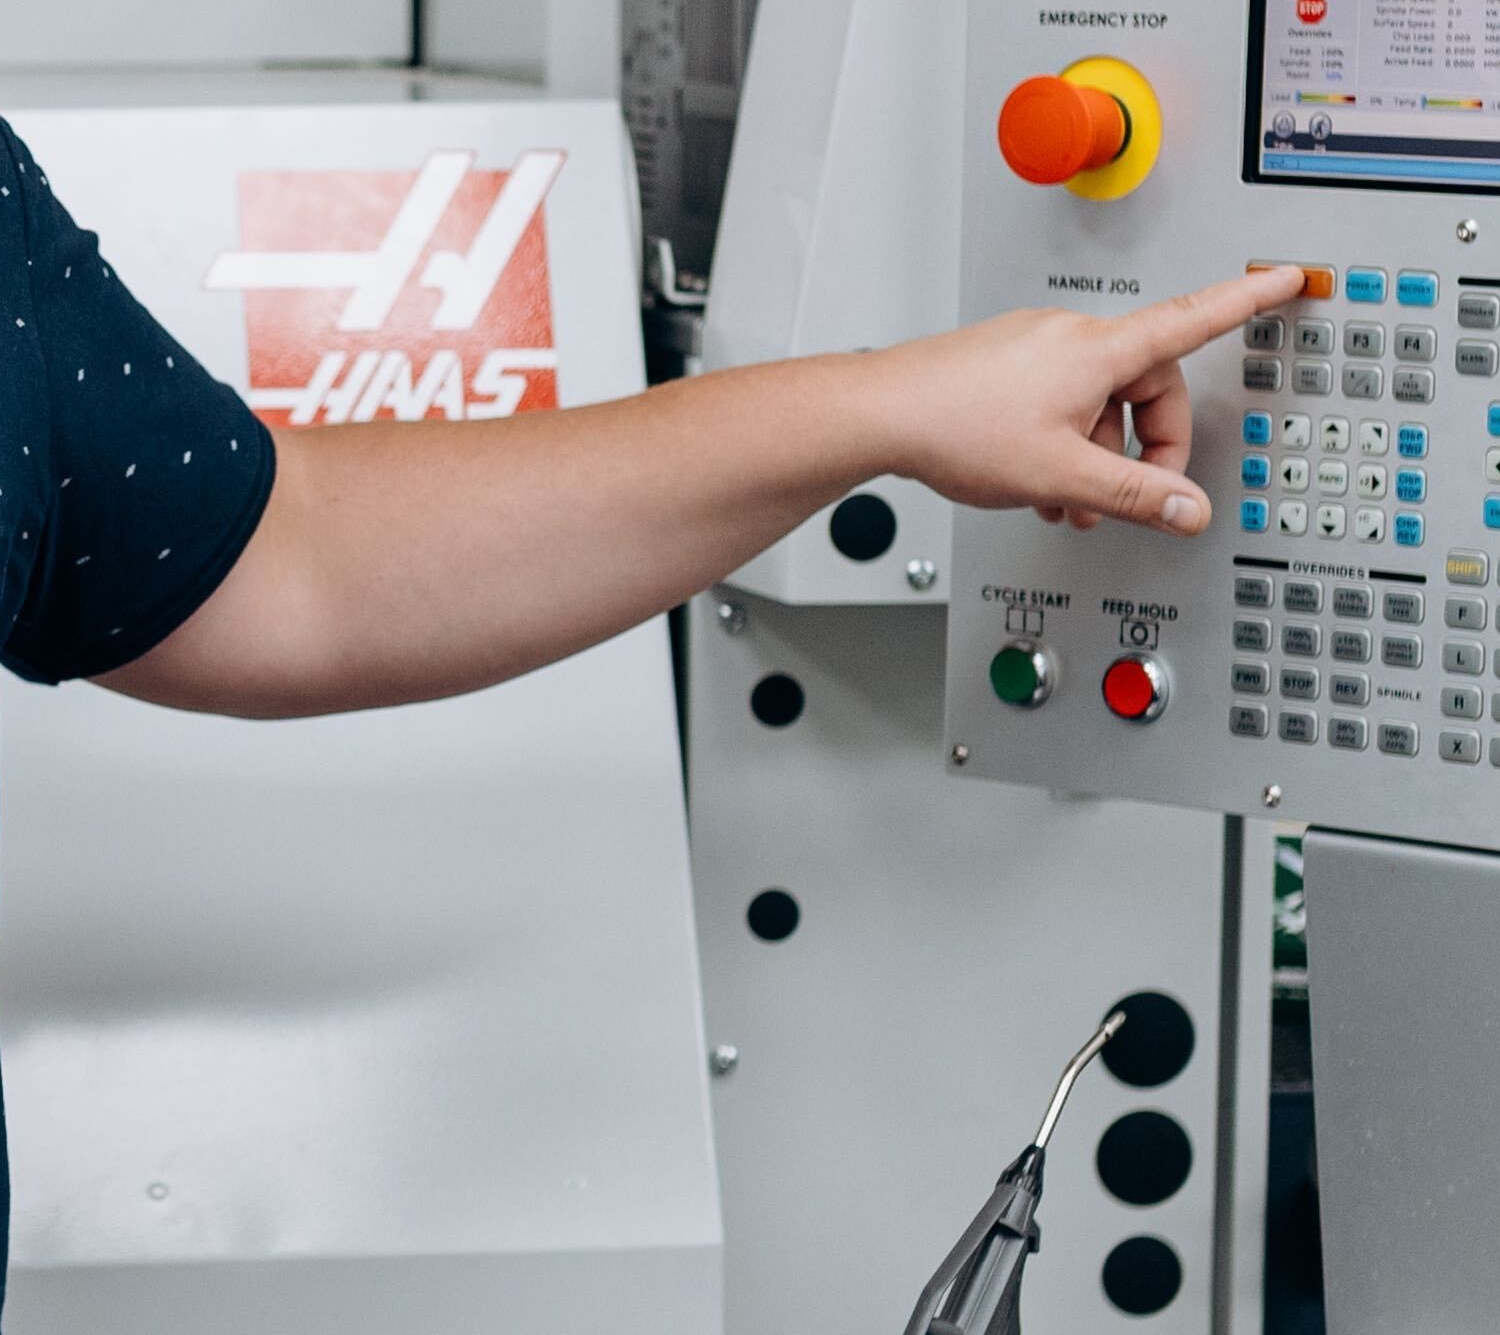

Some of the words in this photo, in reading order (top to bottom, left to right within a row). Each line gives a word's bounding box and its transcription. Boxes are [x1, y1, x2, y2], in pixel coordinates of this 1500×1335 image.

[1299, 1, 1325, 15] STOP
[1039, 10, 1127, 28] EMERGENCY
[1132, 12, 1168, 29] STOP
[1048, 275, 1103, 293] HANDLE
[1109, 278, 1140, 296] JOG
[1254, 329, 1269, 342] F1
[1303, 331, 1319, 345] F2
[1353, 333, 1369, 347] F3
[1404, 337, 1420, 351] F4
[248, 348, 559, 423] HAAS
[1293, 560, 1365, 579] OVERRIDES
[1447, 560, 1482, 577] SHIFT
[981, 584, 1026, 603] CYCLE
[1031, 591, 1071, 610] START
[1102, 598, 1135, 616] FEED
[1138, 602, 1178, 622] HOLD
[1458, 607, 1467, 621] F
[1457, 652, 1465, 665] L
[1236, 672, 1261, 685] FWD
[1284, 677, 1313, 689] STOP
[1336, 684, 1358, 695] REV
[1377, 688, 1422, 702] SPINDLE
[1453, 740, 1462, 753] X
